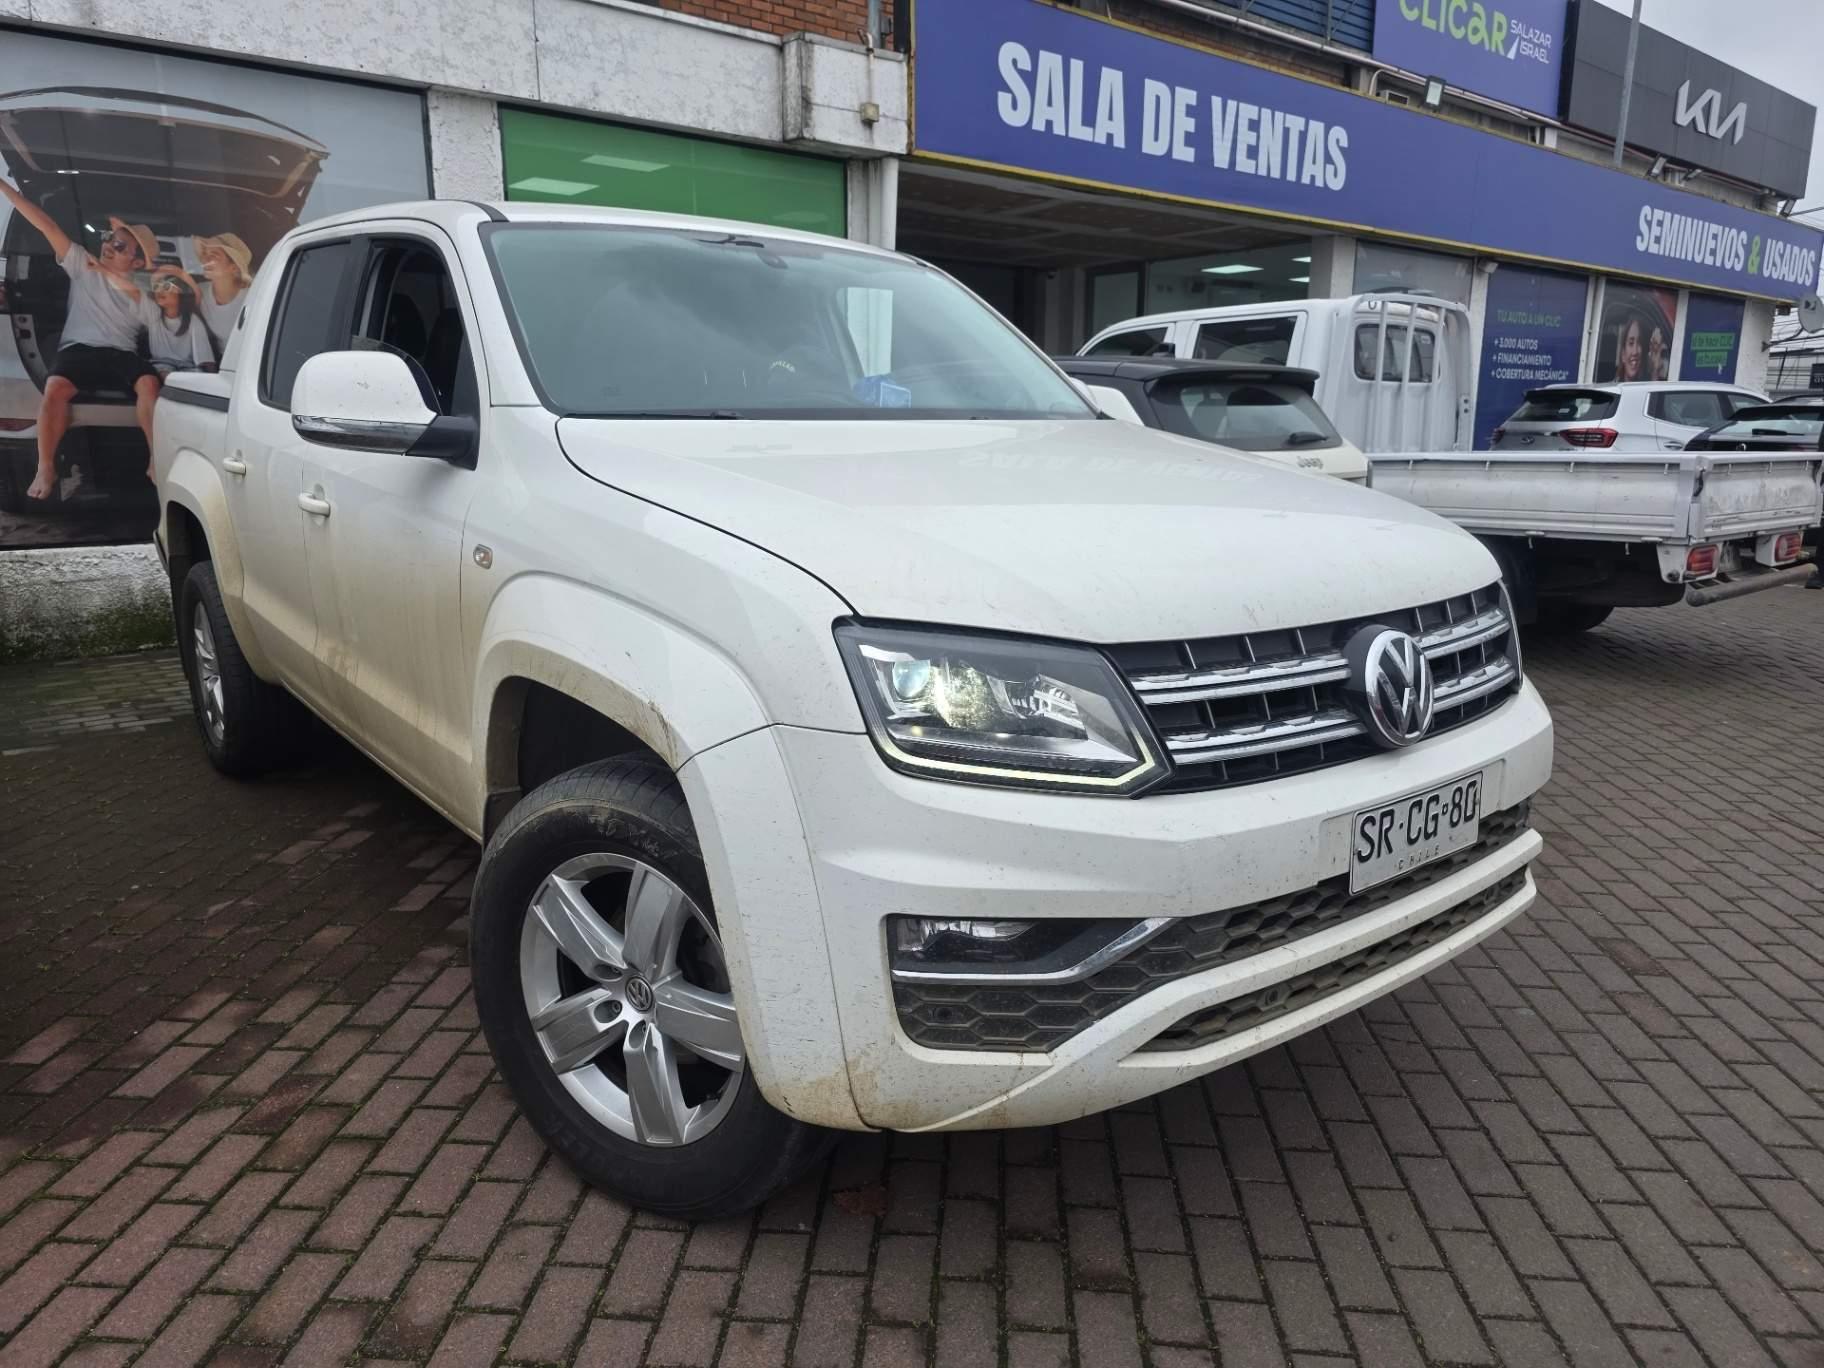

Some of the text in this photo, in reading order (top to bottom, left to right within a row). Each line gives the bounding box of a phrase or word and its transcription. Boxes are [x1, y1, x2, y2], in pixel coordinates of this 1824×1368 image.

[1510, 20, 1551, 48] SALAZAR
[1519, 43, 1550, 64] ISRAEL
[997, 41, 1348, 191] SALA DE VENTAS
[1636, 205, 1816, 287] SEMINUEVOS & USADOS
